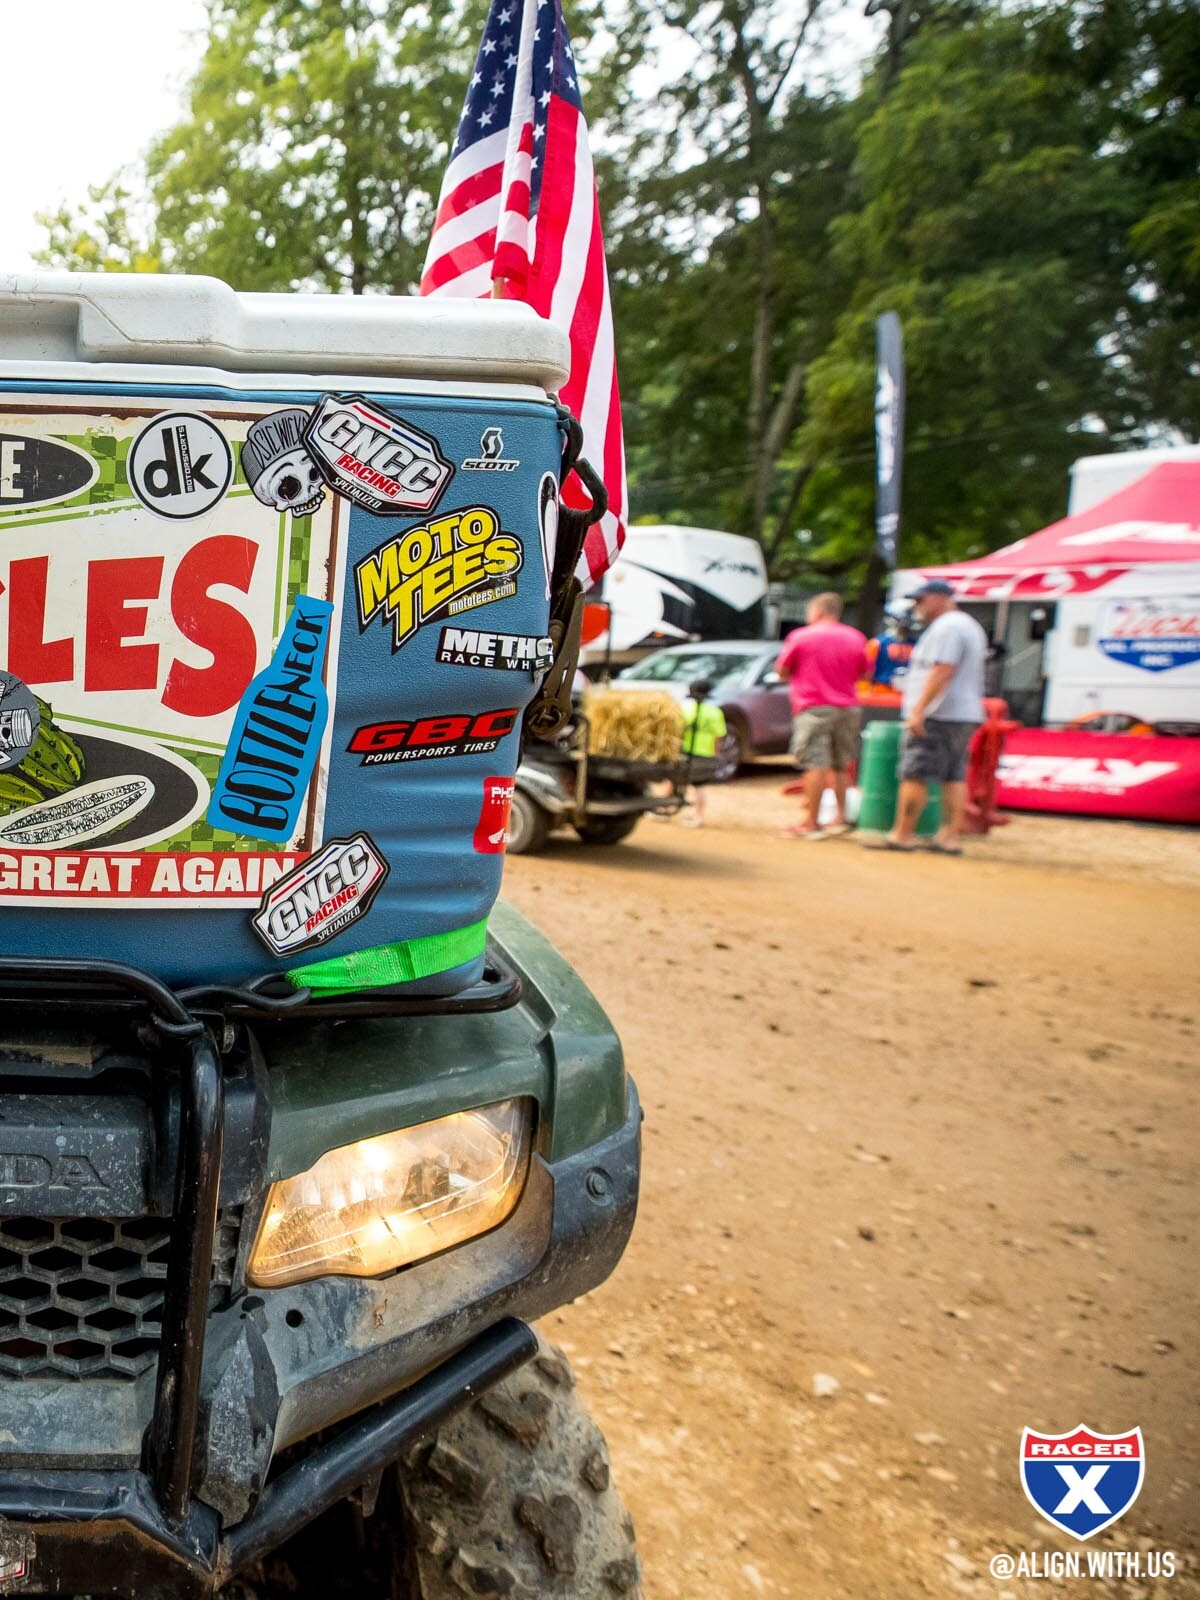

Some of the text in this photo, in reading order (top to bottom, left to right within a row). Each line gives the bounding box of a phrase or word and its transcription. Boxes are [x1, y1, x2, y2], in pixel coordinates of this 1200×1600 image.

[177, 425, 194, 492] MOTORSPORTS
[317, 410, 442, 493] GNCC
[462, 460, 518, 471] SCOTT
[333, 477, 382, 509] SPECIALIZED
[336, 453, 402, 498] RACING
[359, 509, 495, 618] MOTO
[388, 539, 520, 640] TEES
[450, 582, 517, 614] mototees.com
[441, 652, 494, 667] RACE
[350, 709, 520, 751] GBC
[365, 740, 497, 764] POWERSPORTS TIRES
[150, 856, 295, 893] AGAIN
[268, 844, 369, 941] GNCC
[305, 884, 359, 934] RACING
[317, 906, 360, 940] SPECIALIZED
